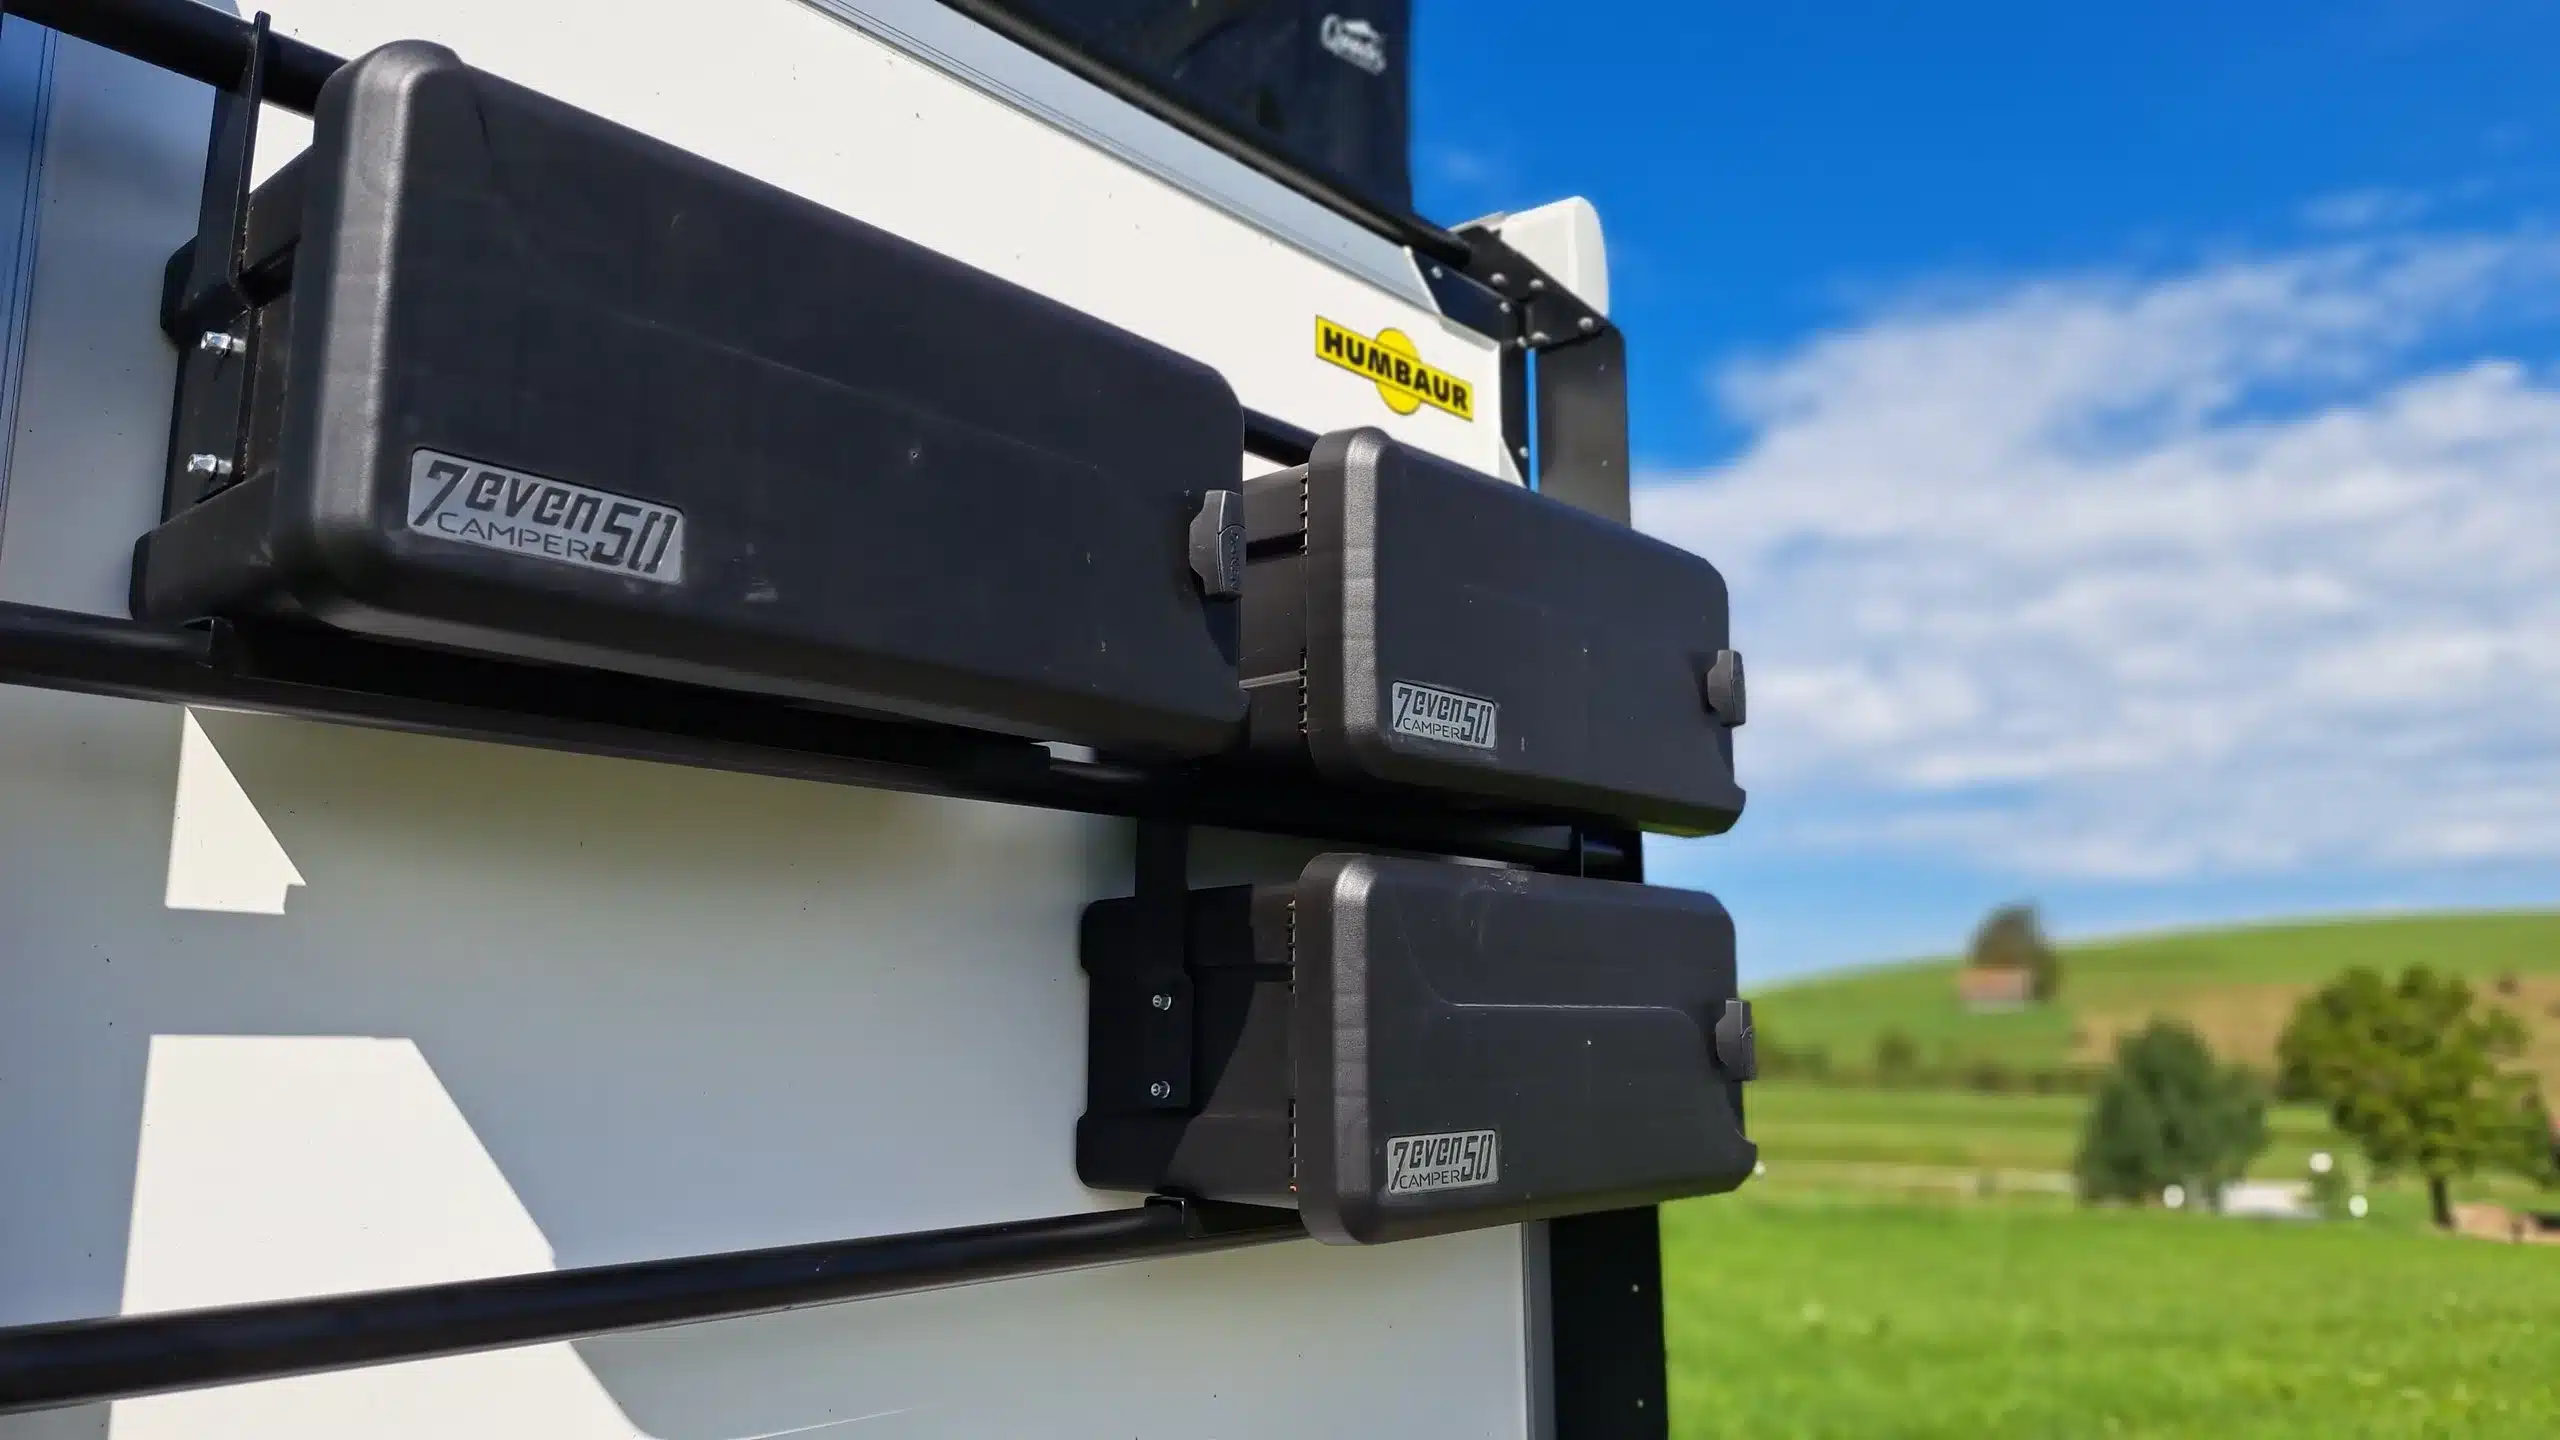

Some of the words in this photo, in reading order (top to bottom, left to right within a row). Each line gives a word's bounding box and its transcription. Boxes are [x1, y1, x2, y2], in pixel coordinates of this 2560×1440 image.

[1323, 326, 1469, 412] HUMBAUR
[436, 511, 591, 562] CAMPER
[1402, 717, 1460, 740] CAMPER
[1399, 1169, 1461, 1189] CAMPER
